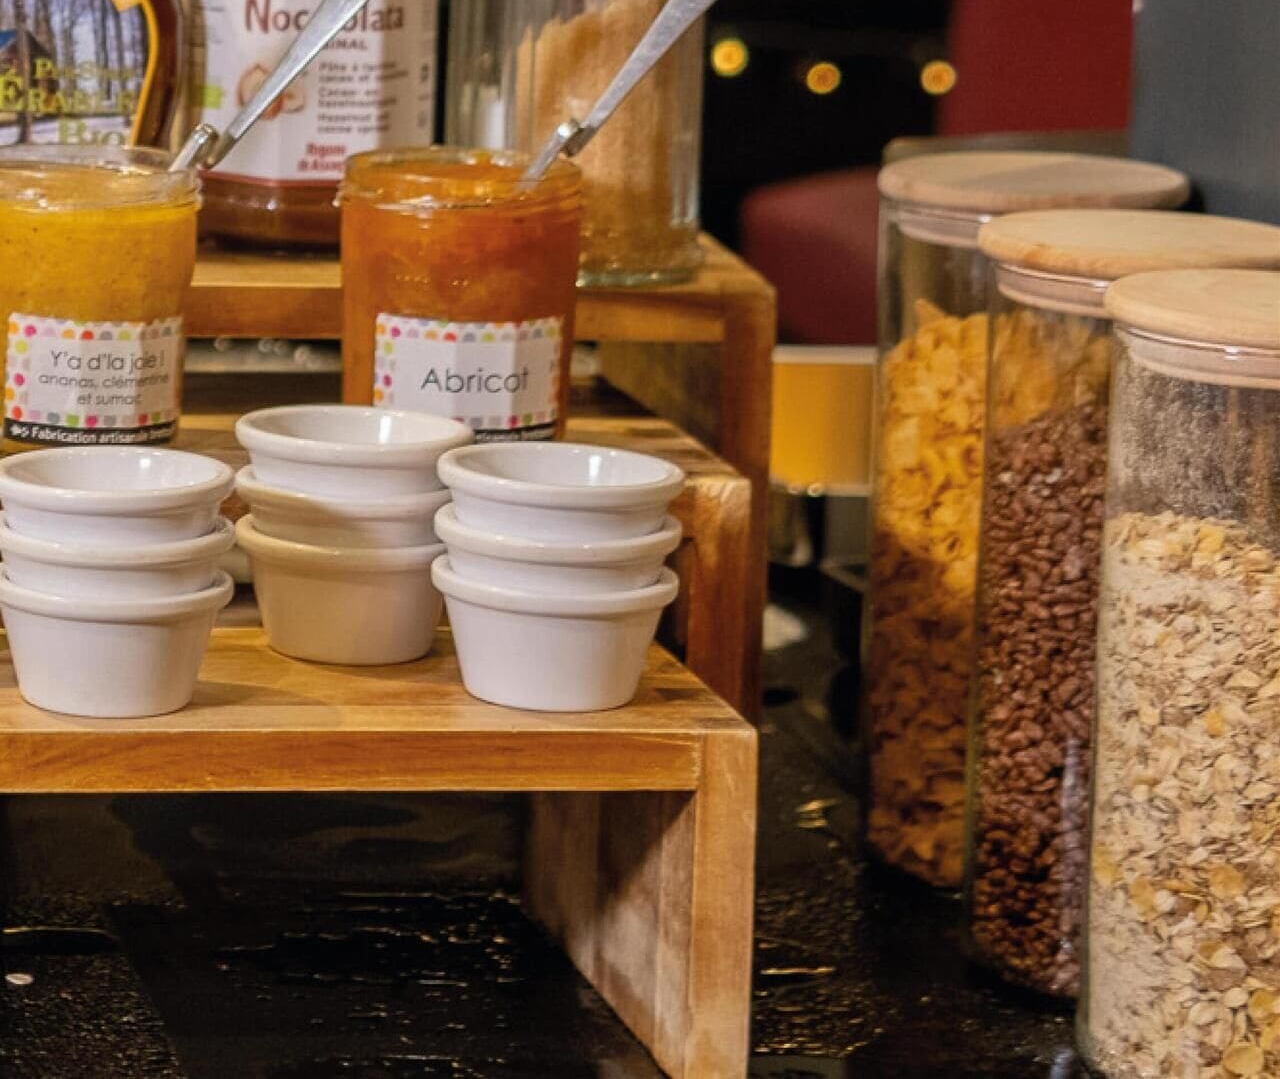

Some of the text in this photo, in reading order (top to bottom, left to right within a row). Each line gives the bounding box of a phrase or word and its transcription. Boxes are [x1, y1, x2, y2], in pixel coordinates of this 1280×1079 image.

[420, 367, 529, 394] Abricot
[77, 393, 92, 406] et
[31, 427, 97, 444] Fabrication
